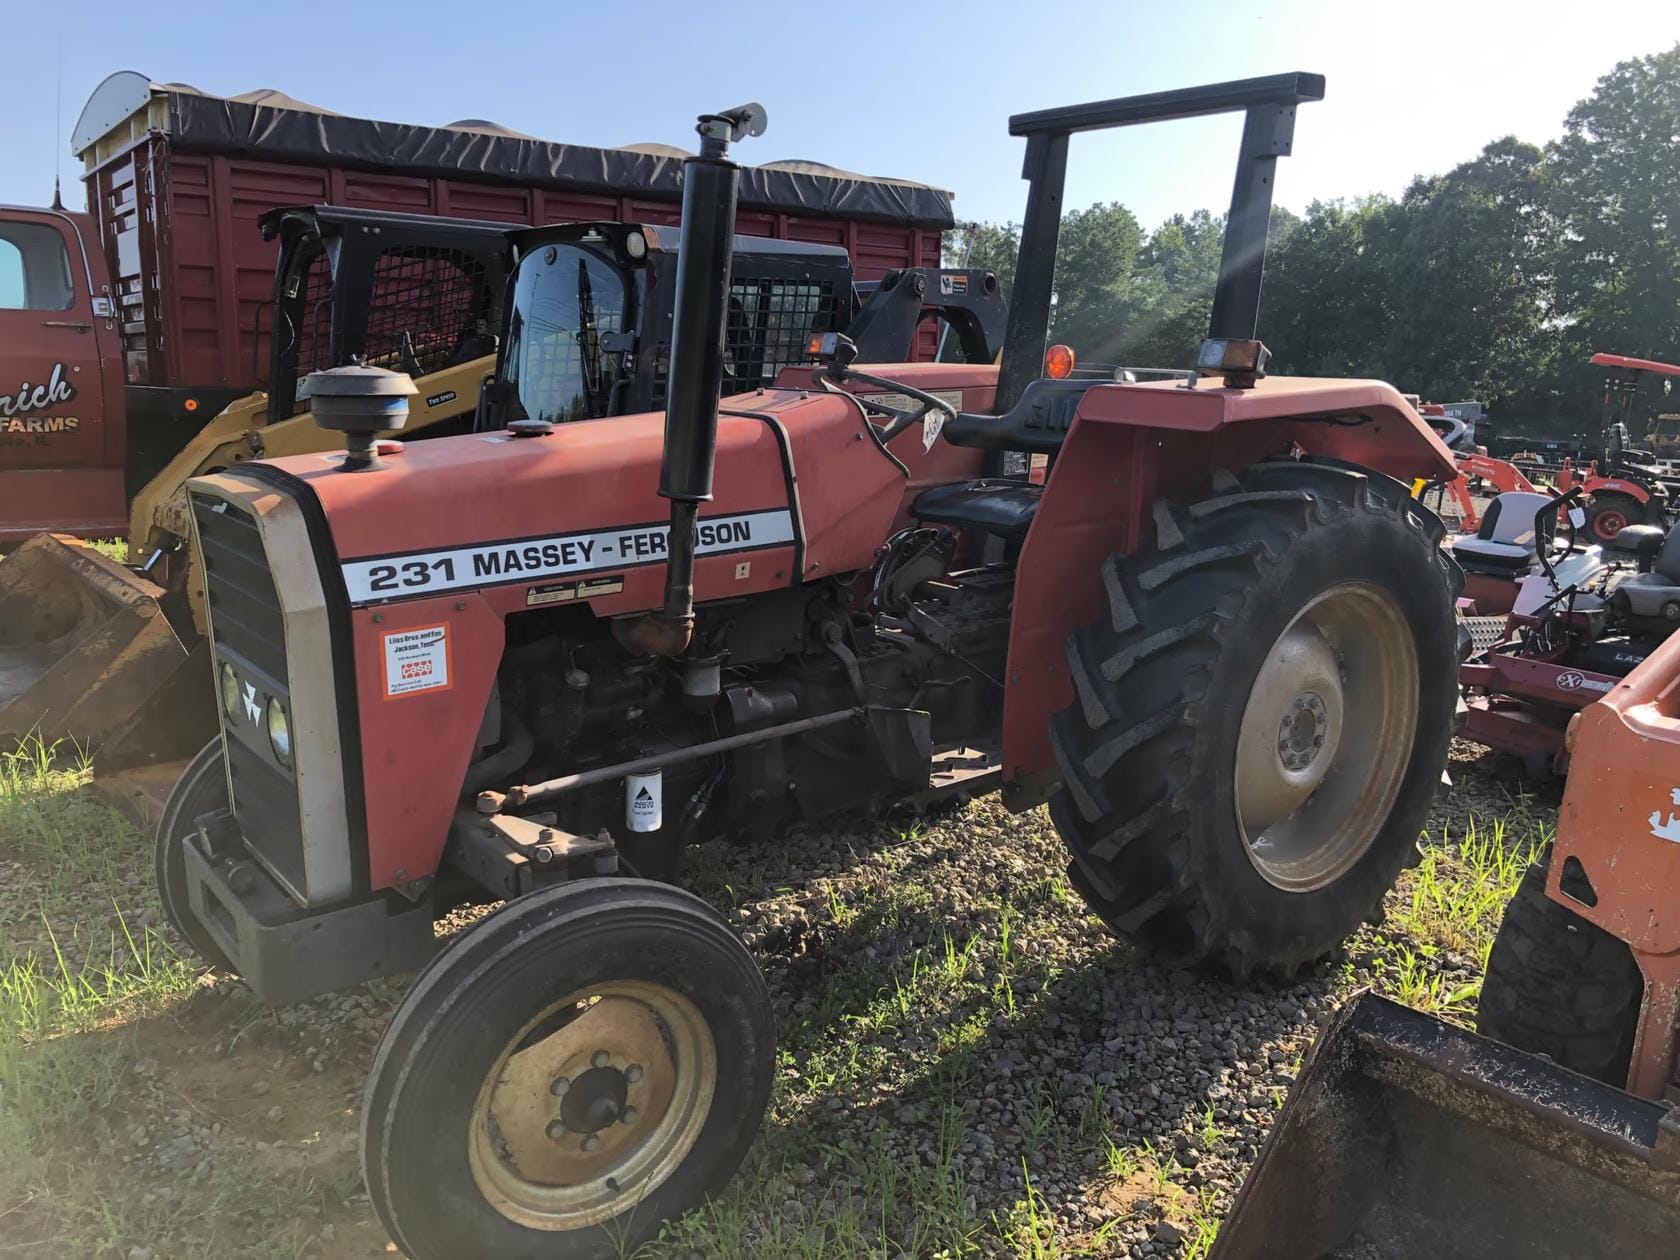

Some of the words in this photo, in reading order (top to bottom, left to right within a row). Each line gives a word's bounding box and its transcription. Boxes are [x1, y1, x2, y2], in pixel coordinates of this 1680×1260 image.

[0, 416, 79, 432] FARMS
[369, 558, 455, 592] 231
[473, 540, 595, 577] MASSEY
[619, 520, 751, 558] FERSON
